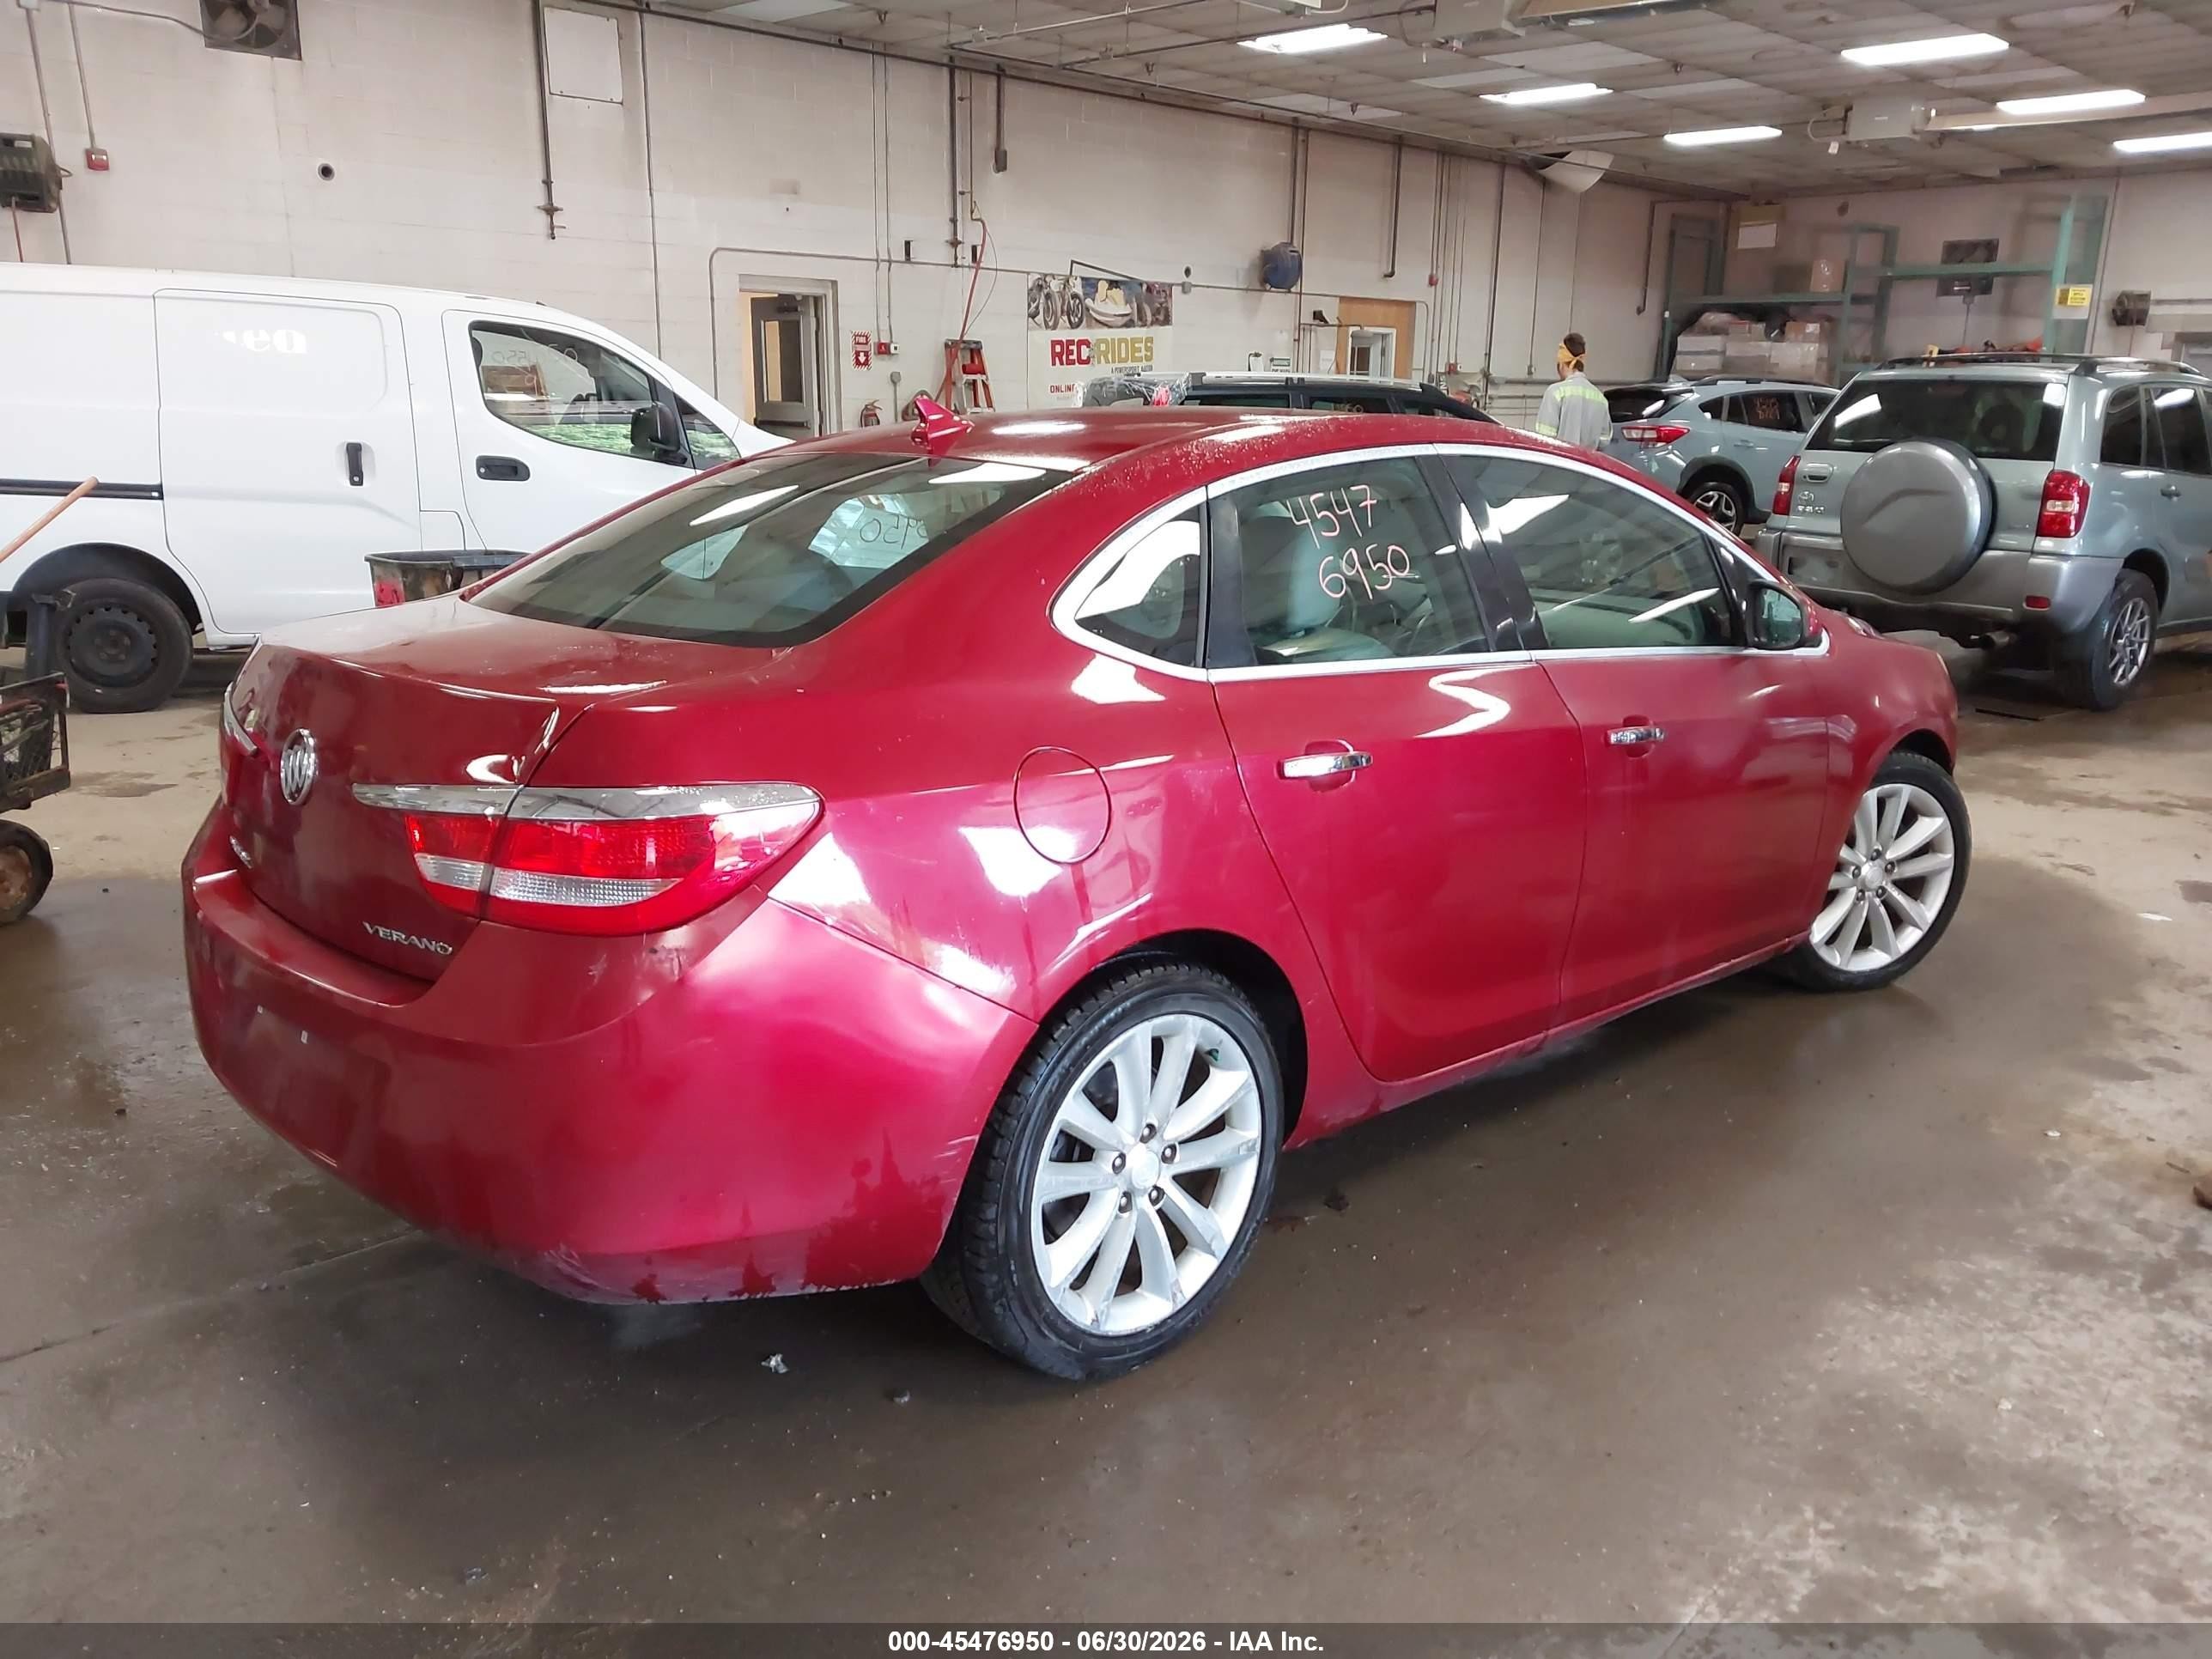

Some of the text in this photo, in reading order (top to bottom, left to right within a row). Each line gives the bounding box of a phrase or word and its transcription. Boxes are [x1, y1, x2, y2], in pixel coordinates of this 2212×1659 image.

[1050, 338, 1091, 367] REC
[1095, 336, 1154, 365] RIDES
[1286, 484, 1377, 550] 4547
[1319, 544, 1411, 600] 6950
[362, 921, 453, 955] VERANO
